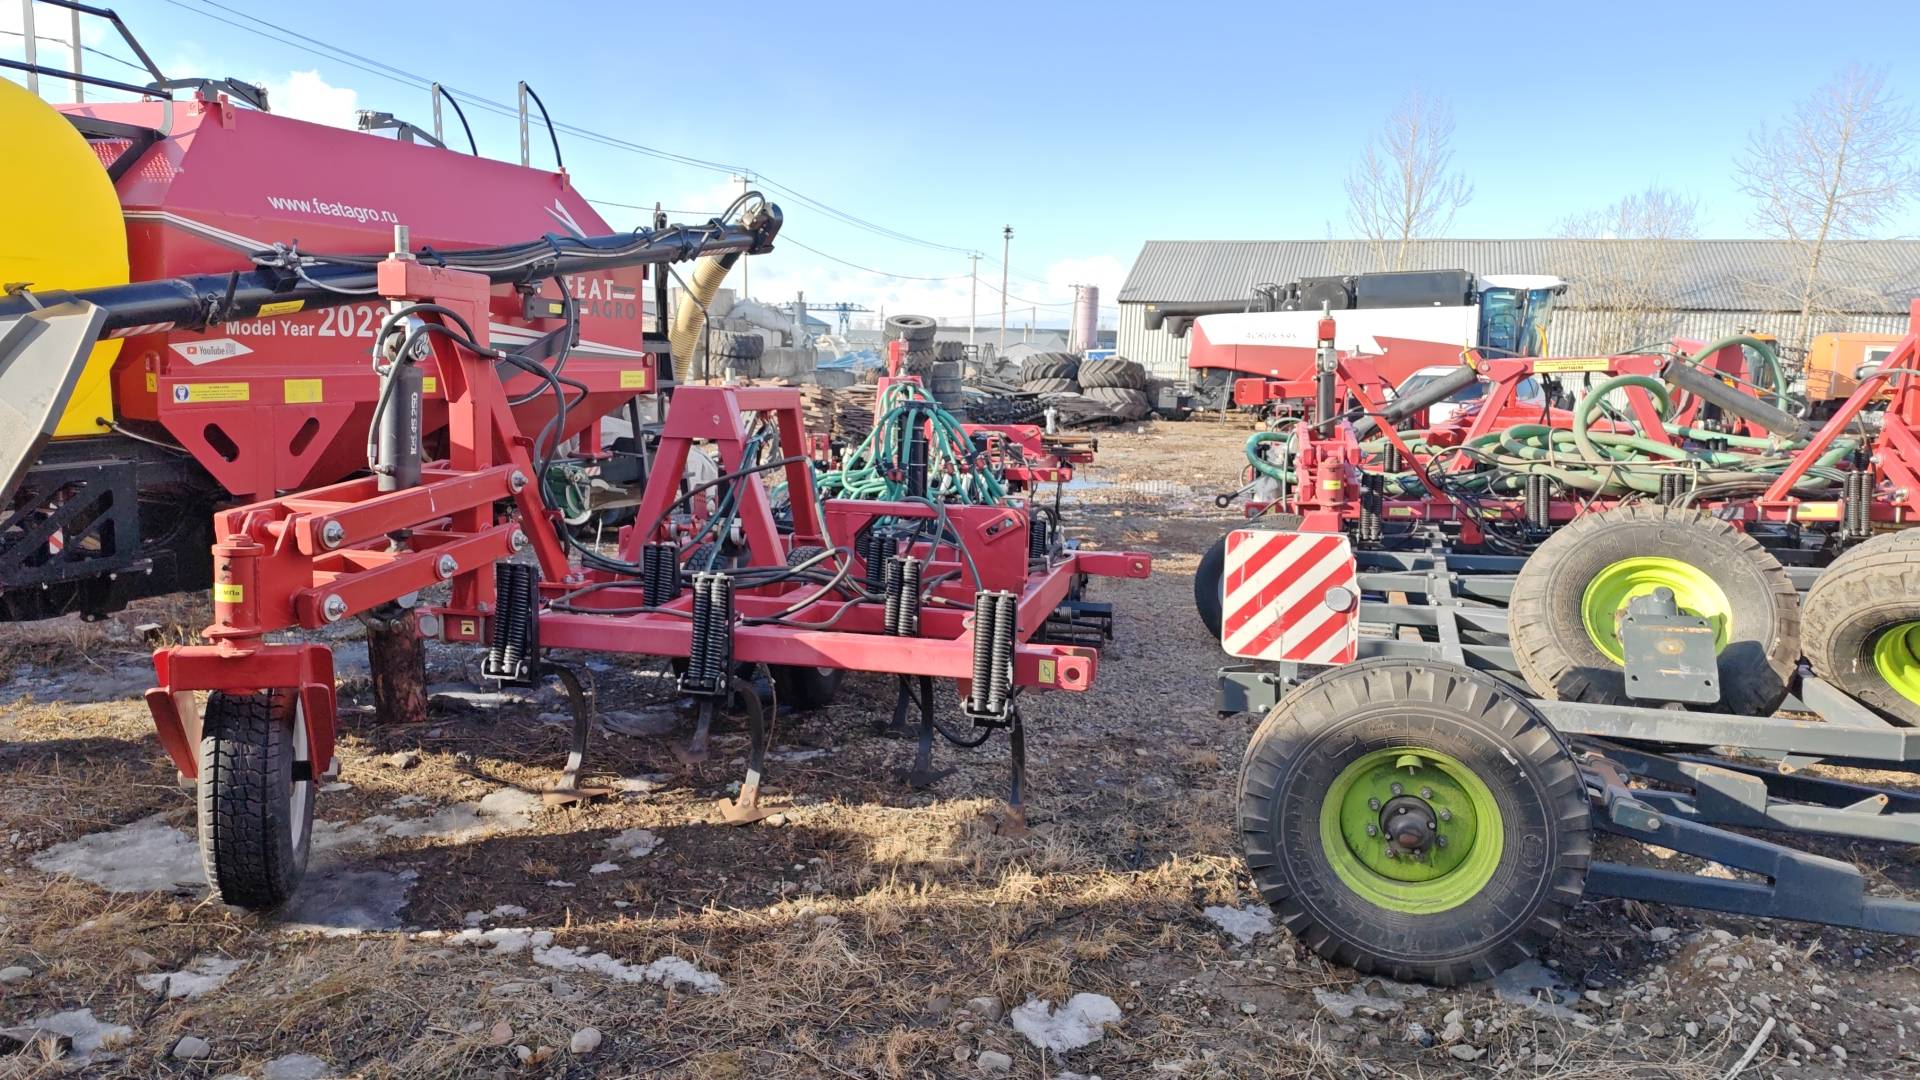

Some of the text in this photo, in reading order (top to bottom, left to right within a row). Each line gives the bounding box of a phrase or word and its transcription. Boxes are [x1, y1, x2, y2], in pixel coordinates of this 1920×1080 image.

[267, 196, 399, 224] www.featagro.ru
[591, 300, 636, 320] AGRO
[225, 319, 276, 336] Model
[280, 320, 315, 337] Year
[199, 345, 226, 356] YouTube
